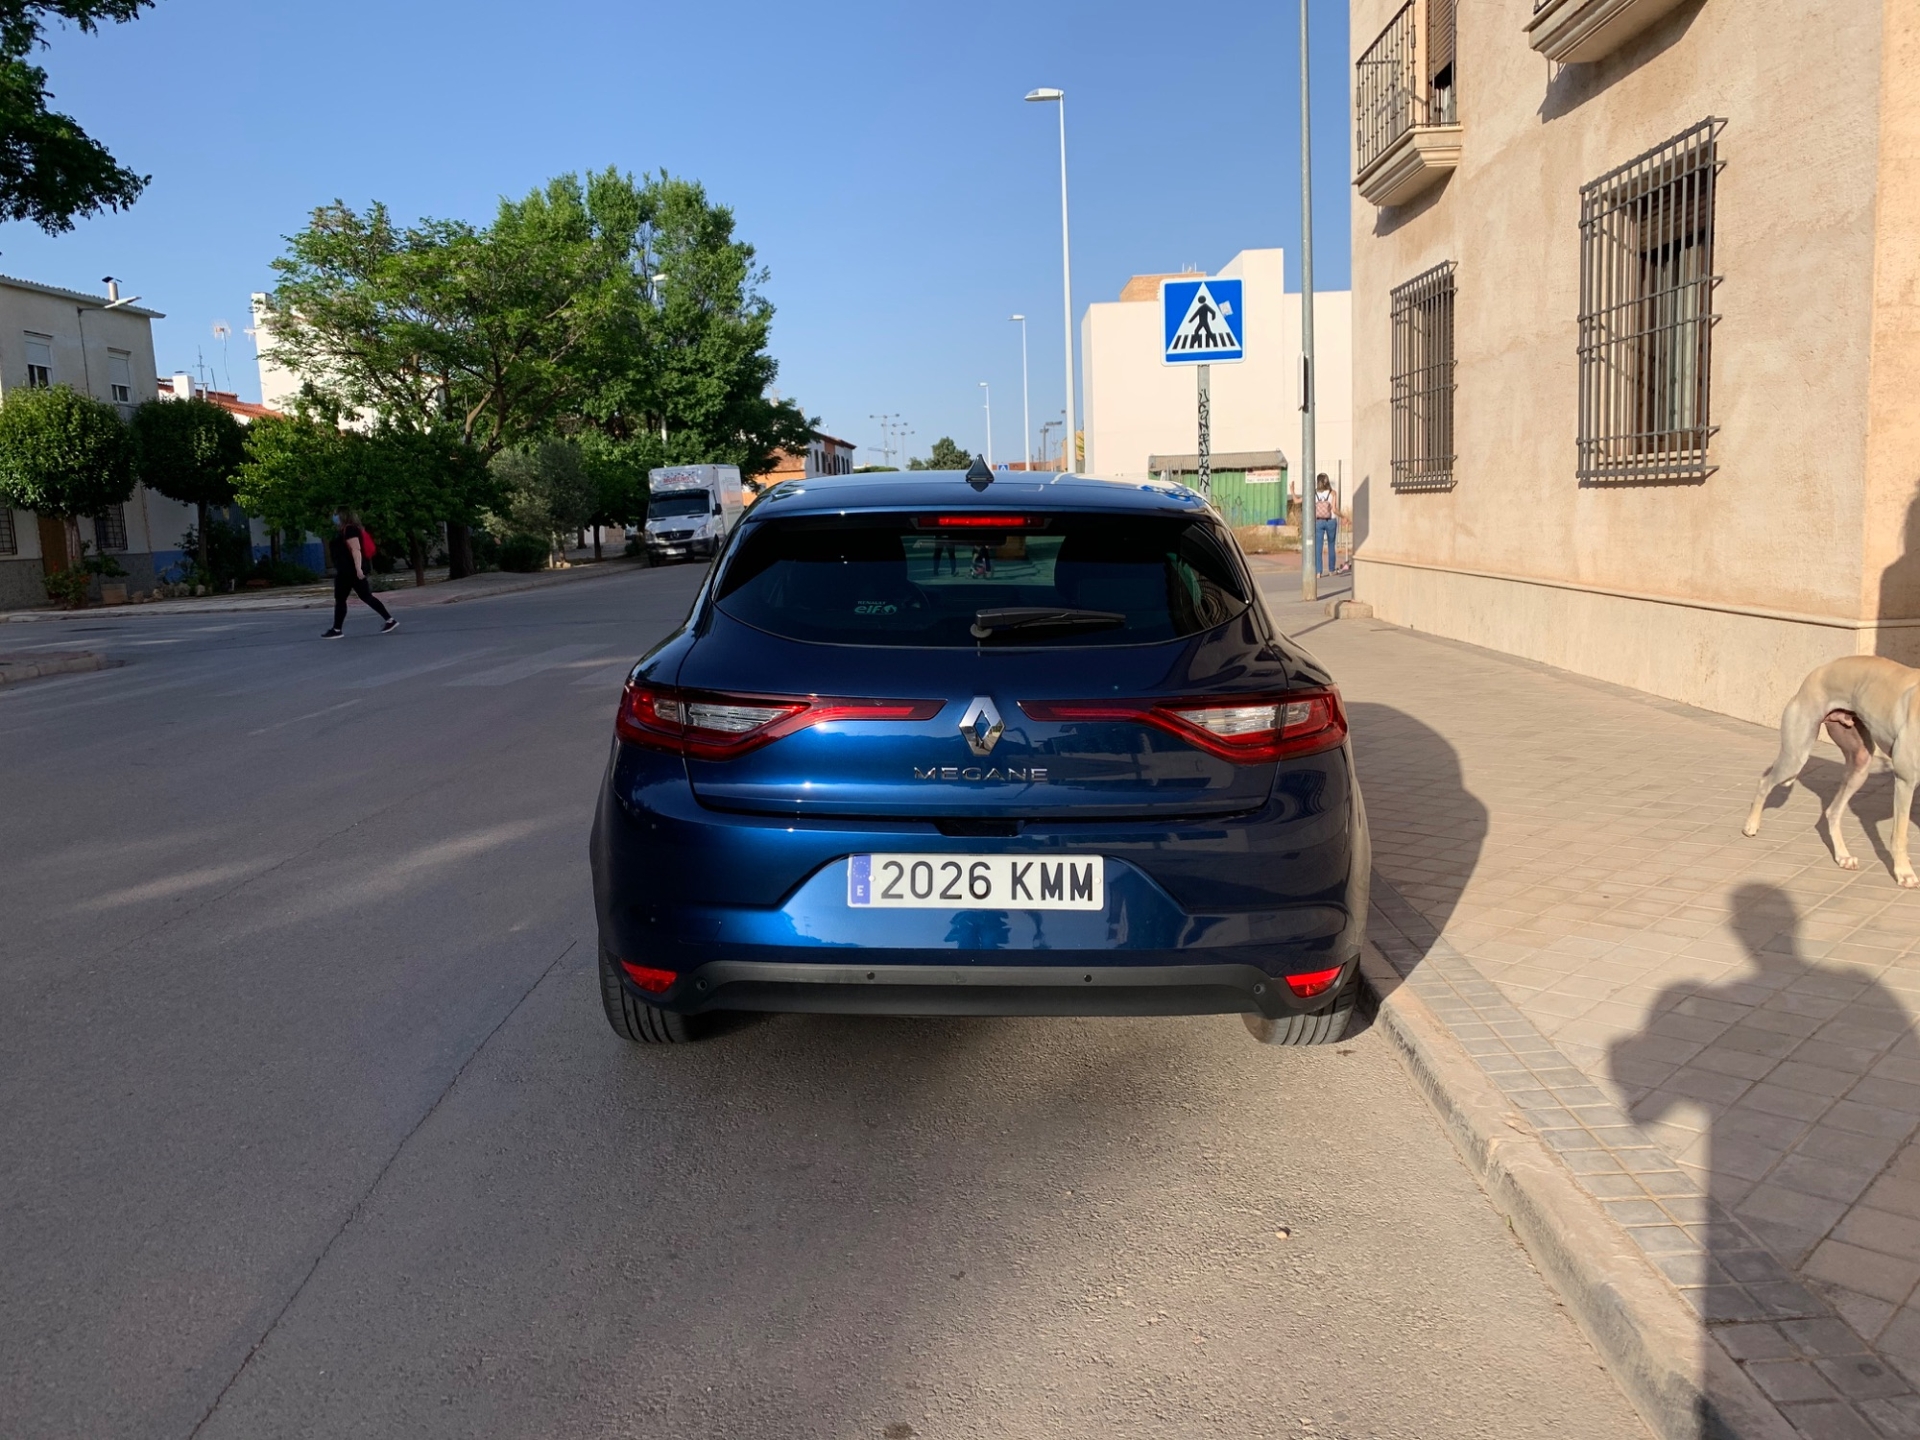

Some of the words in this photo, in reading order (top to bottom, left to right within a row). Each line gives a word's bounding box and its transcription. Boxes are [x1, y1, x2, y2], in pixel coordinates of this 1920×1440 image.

[854, 605, 882, 614] elf
[914, 767, 1048, 781] MEGANE
[881, 860, 991, 900] 2026
[1011, 862, 1093, 902] KMM
[857, 885, 864, 896] E
